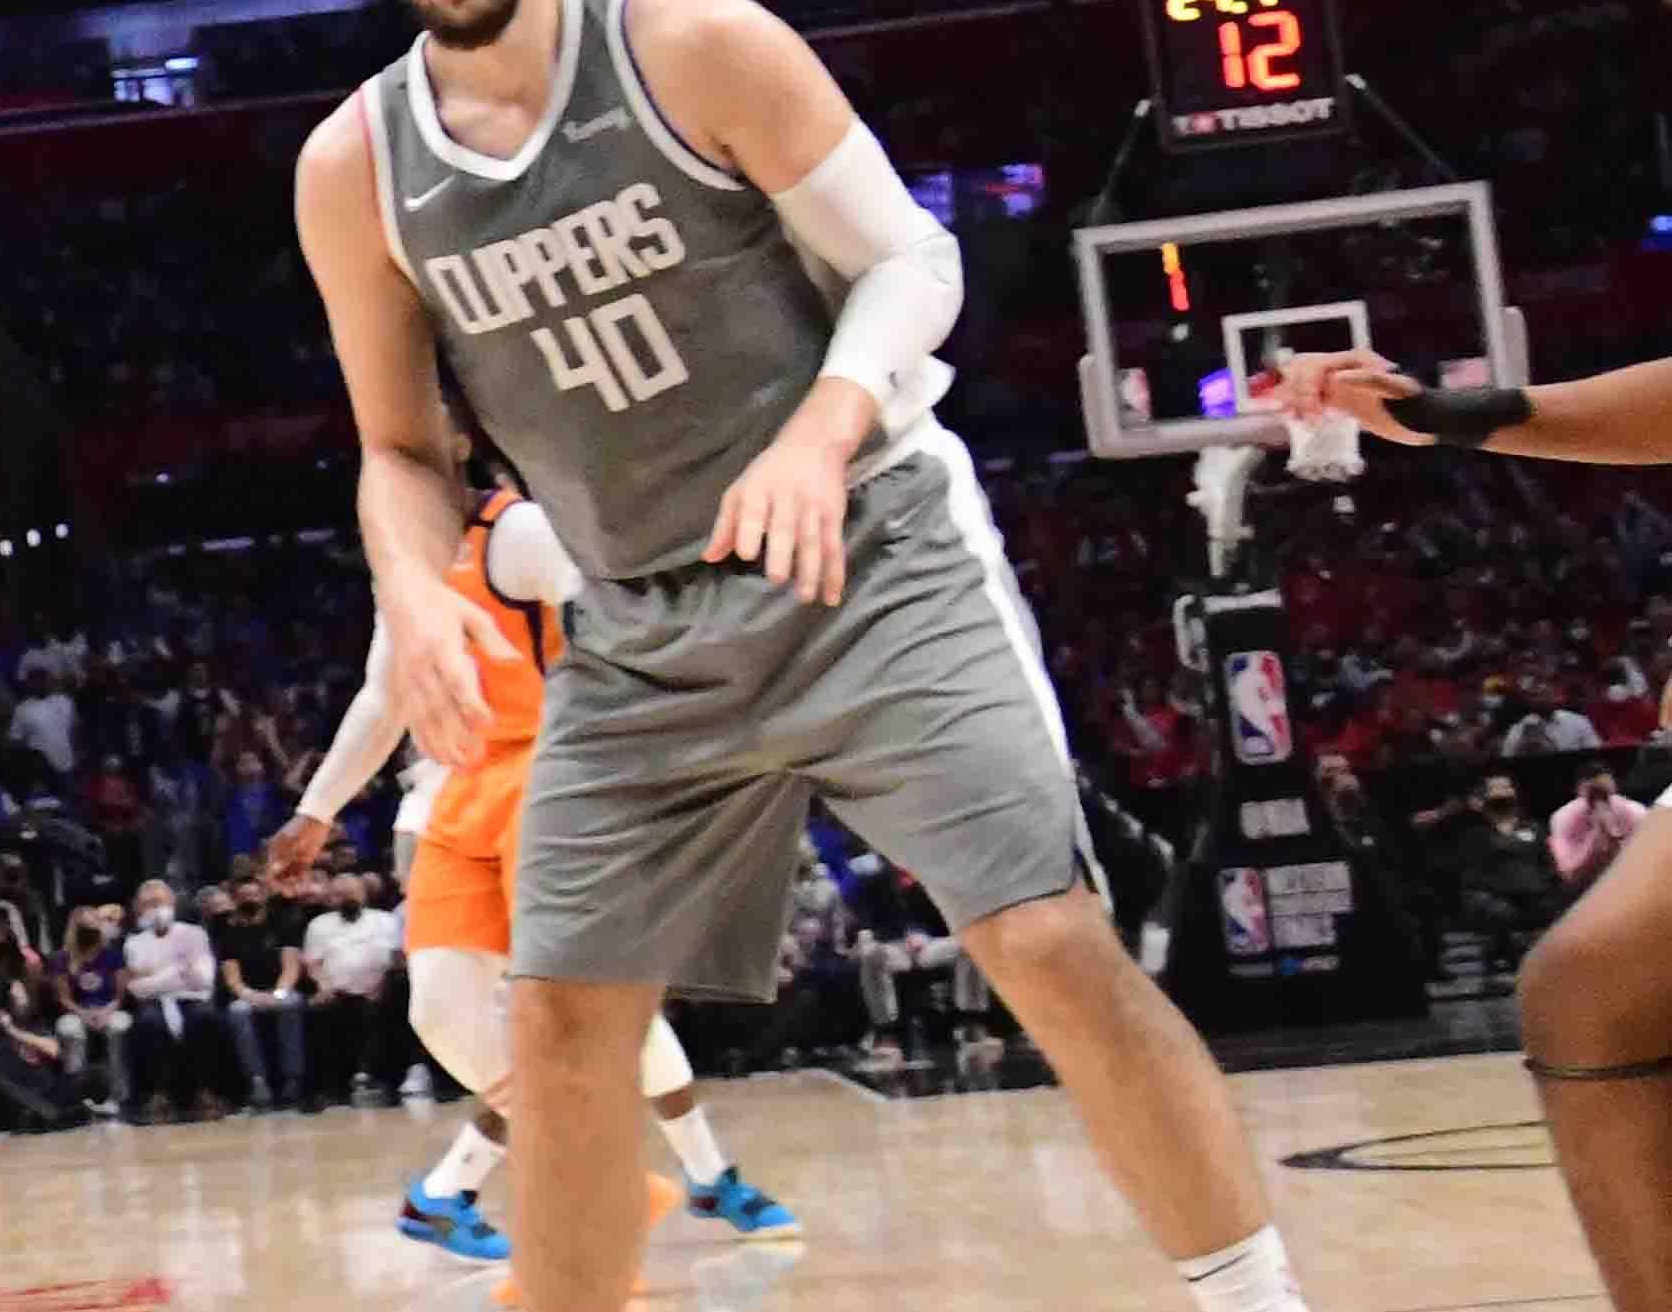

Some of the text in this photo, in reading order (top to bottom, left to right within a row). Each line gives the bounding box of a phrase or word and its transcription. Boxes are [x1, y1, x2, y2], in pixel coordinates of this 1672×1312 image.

[1217, 9, 1302, 92] 12
[1216, 97, 1335, 131] TISSOT
[424, 182, 686, 336] CLIPPERS
[530, 293, 689, 412] 40
